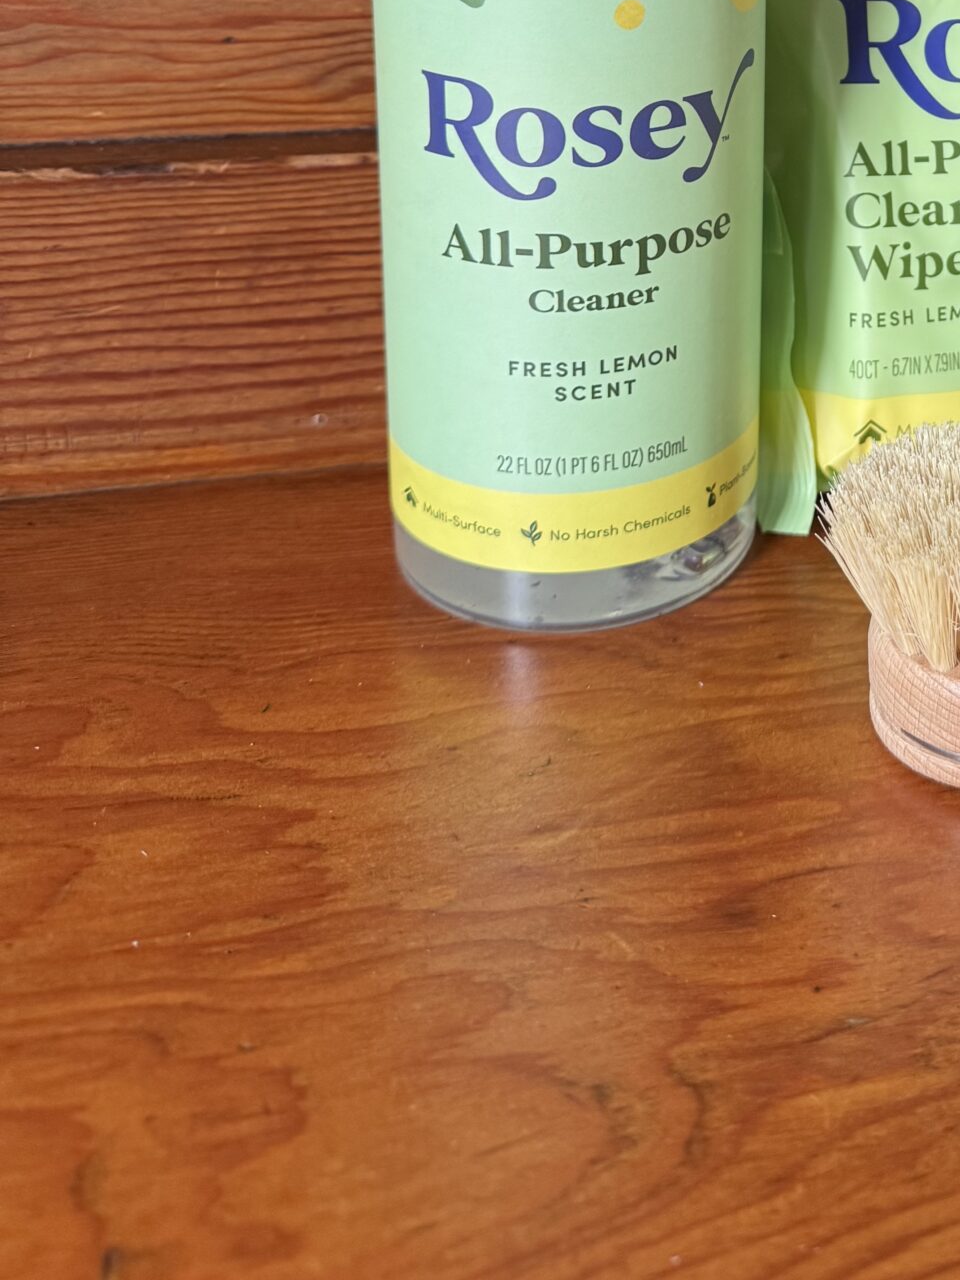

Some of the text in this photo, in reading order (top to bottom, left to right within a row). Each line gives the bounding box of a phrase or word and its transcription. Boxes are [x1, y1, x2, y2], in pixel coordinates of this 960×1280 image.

[421, 48, 755, 200] Rosey
[442, 212, 731, 276] All-Purpose
[528, 285, 660, 313] Cleaner
[849, 308, 914, 328] FRESH
[509, 345, 678, 377] FRESH LEMON
[849, 359, 879, 379] 40CT
[892, 356, 921, 376] 6.7IN
[924, 354, 933, 374] X
[935, 351, 960, 372] 7.9IN
[555, 379, 637, 402] SCENT
[497, 436, 688, 477] 22 FL OZ (1 PT 6 FL OZ) 650mL
[422, 502, 501, 538] Multi-Surface
[550, 504, 691, 542] No Harsh Chemicals
